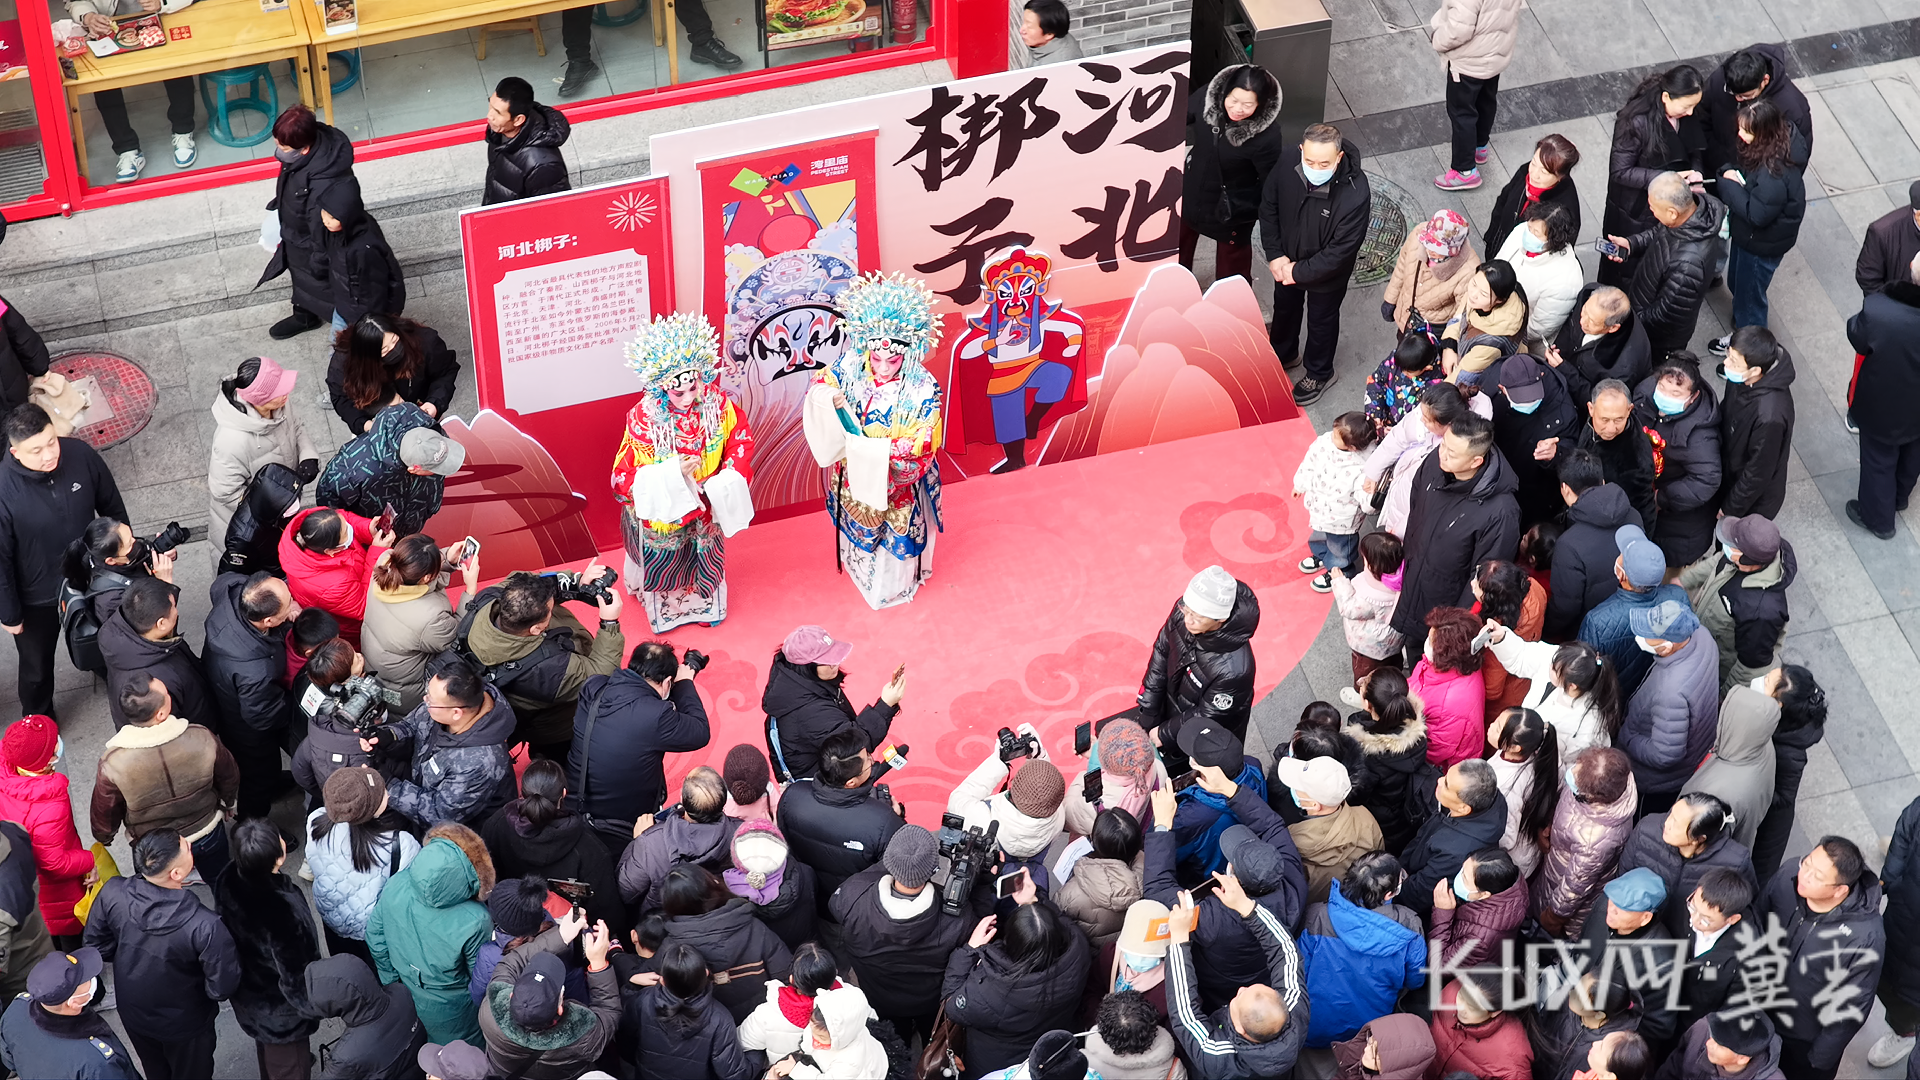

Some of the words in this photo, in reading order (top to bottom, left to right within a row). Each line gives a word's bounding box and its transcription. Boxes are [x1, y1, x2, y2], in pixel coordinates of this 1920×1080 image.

[810, 155, 849, 170] 湾里庙
[1060, 51, 1191, 272] 河北
[810, 164, 849, 175] PEDESTRIAN
[825, 168, 849, 177] STREET
[524, 260, 642, 288] 河北省最具代表性的地方声腔剧
